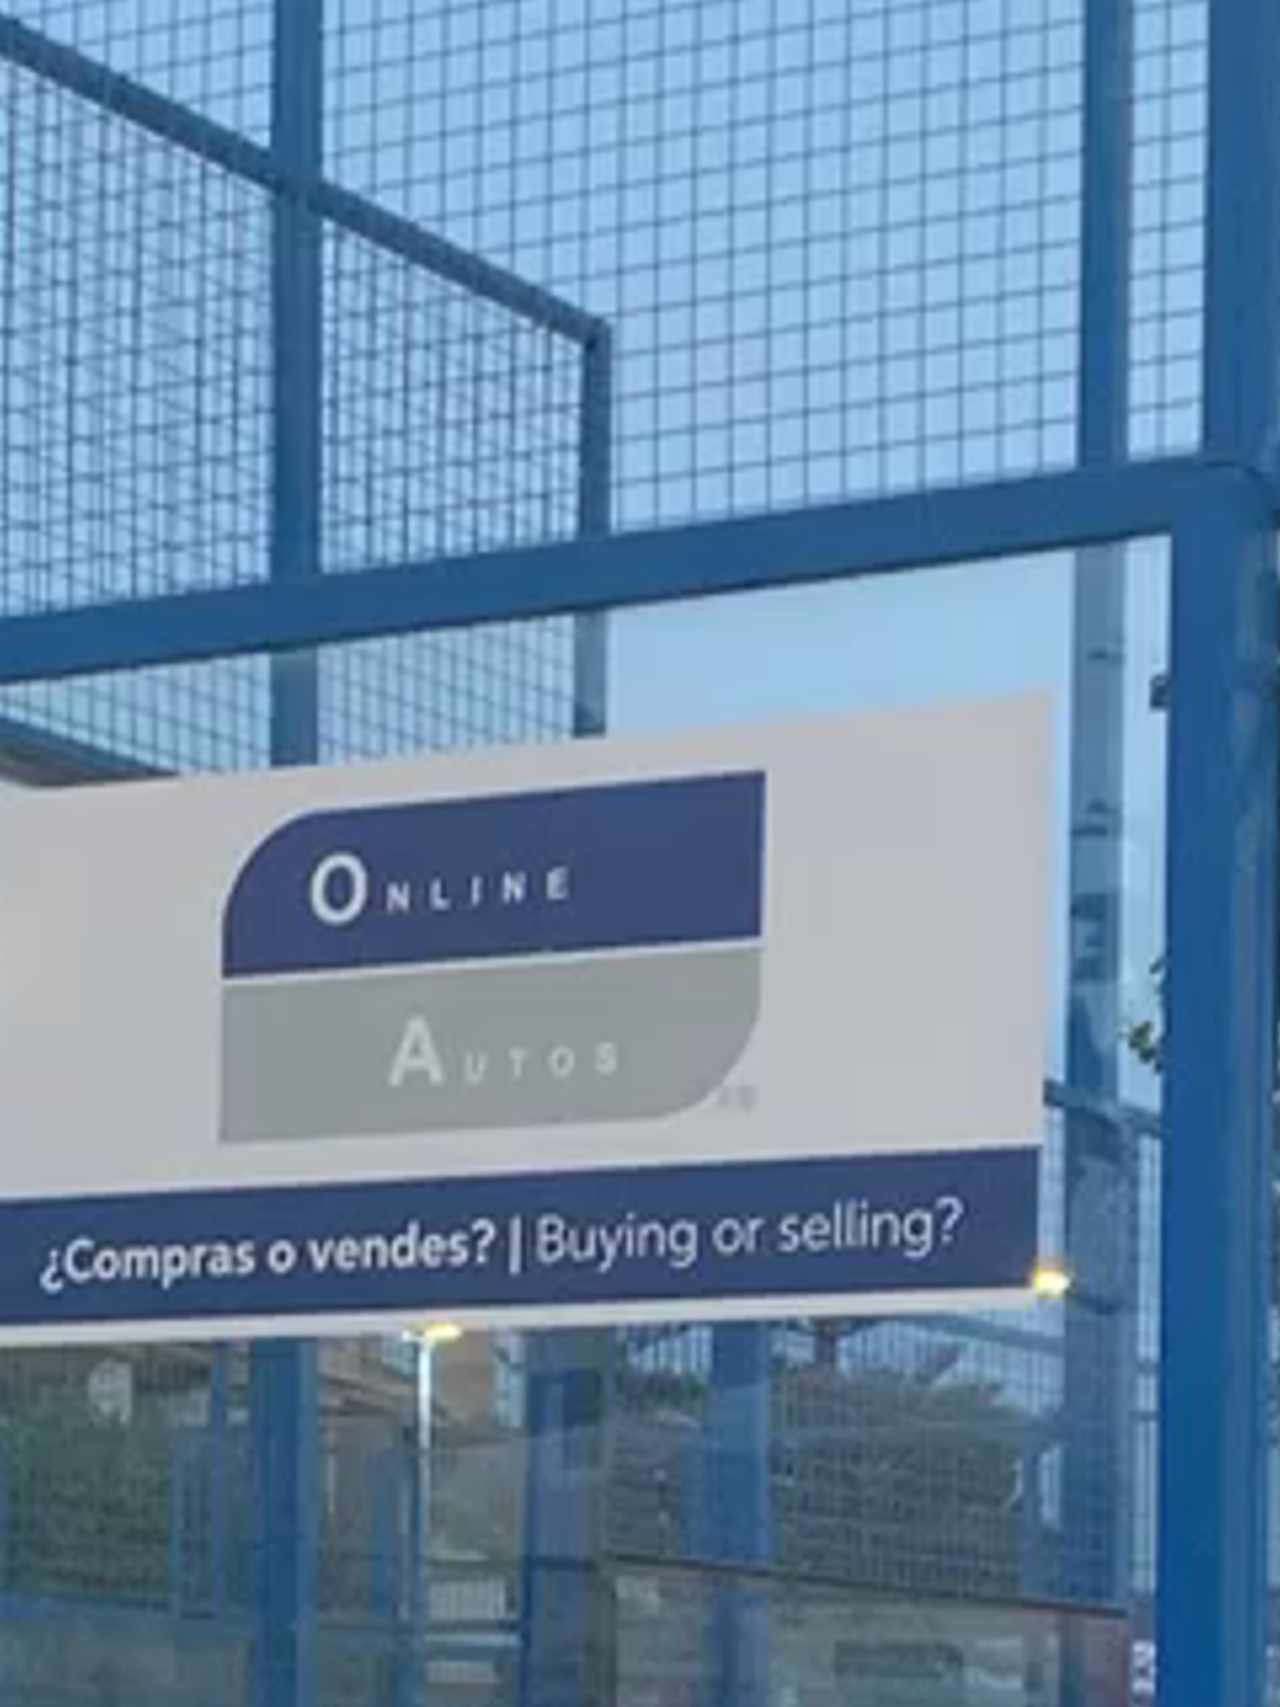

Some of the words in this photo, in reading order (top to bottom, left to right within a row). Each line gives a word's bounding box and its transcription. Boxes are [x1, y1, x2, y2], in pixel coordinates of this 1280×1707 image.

[39, 1235, 256, 1293] ¿Compras
[267, 1239, 297, 1274] o
[307, 1218, 496, 1272] vendes?
[536, 1211, 698, 1273] Buying
[712, 1216, 763, 1255] or
[777, 1195, 965, 1259] selling?
